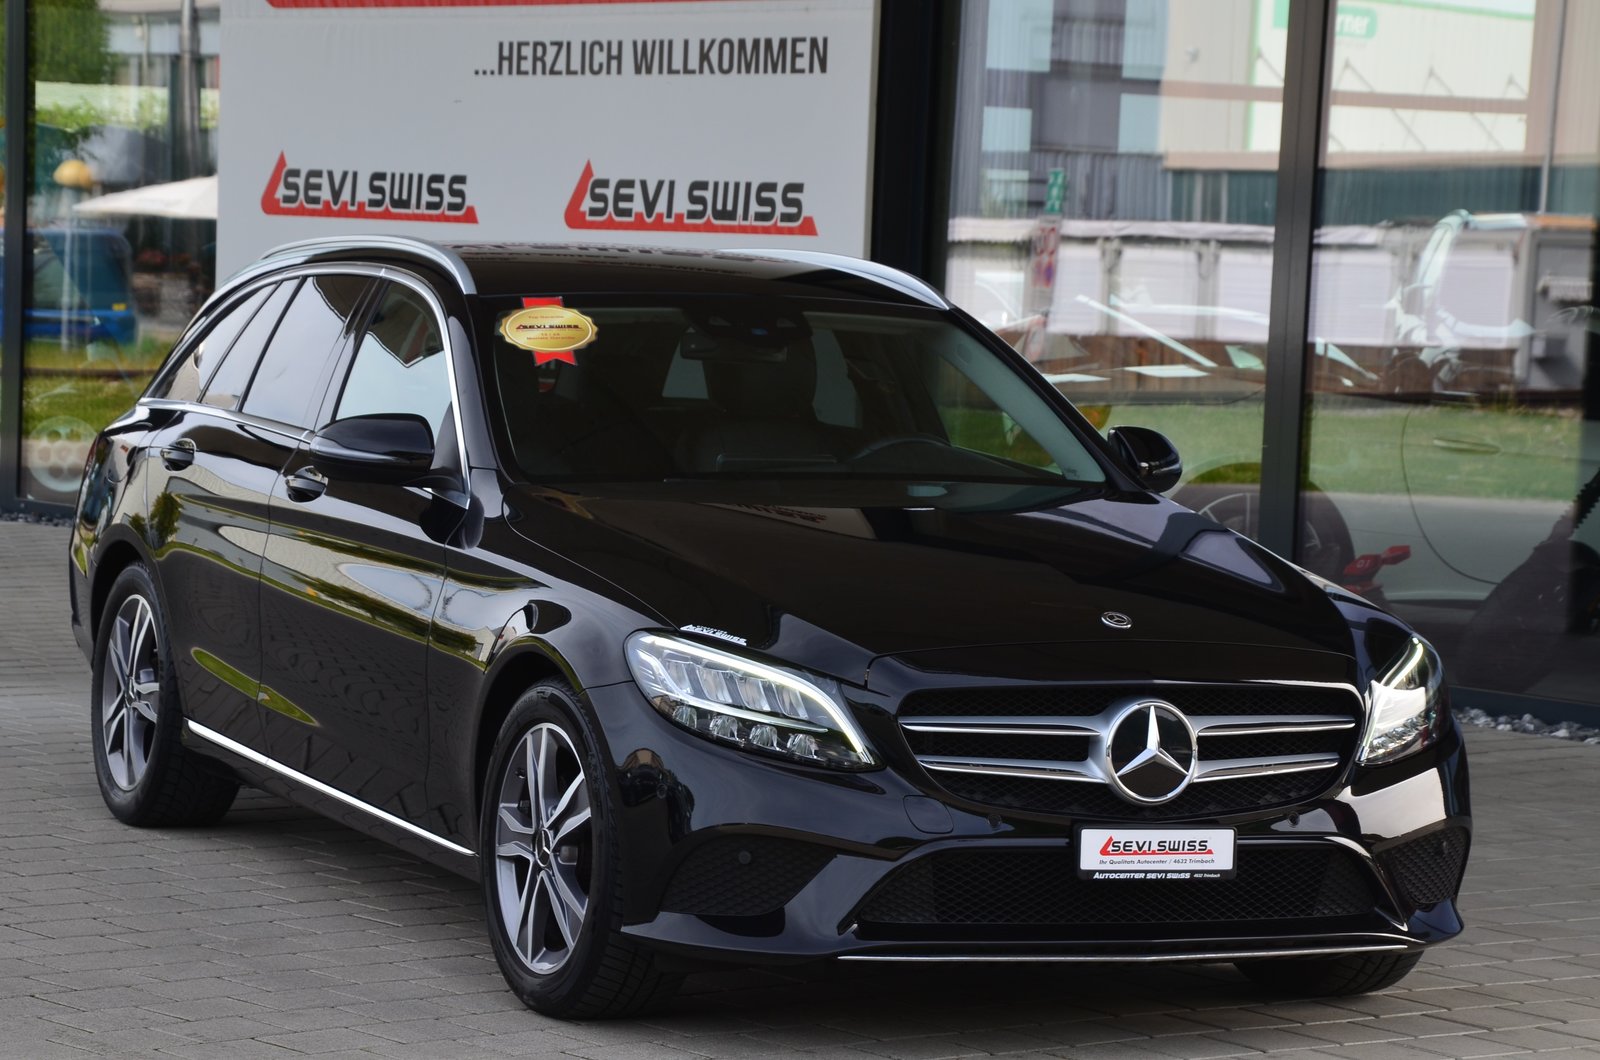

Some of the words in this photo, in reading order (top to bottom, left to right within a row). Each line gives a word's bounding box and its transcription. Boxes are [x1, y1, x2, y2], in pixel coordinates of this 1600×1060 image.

[632, 37, 829, 75] WILLKOMMEN
[282, 168, 358, 211] SEVI
[365, 172, 467, 212] SWISS
[588, 178, 676, 219] SEVI
[686, 181, 804, 223] SWISS
[1111, 840, 1152, 853] SEVI
[1157, 839, 1208, 852] SWISS
